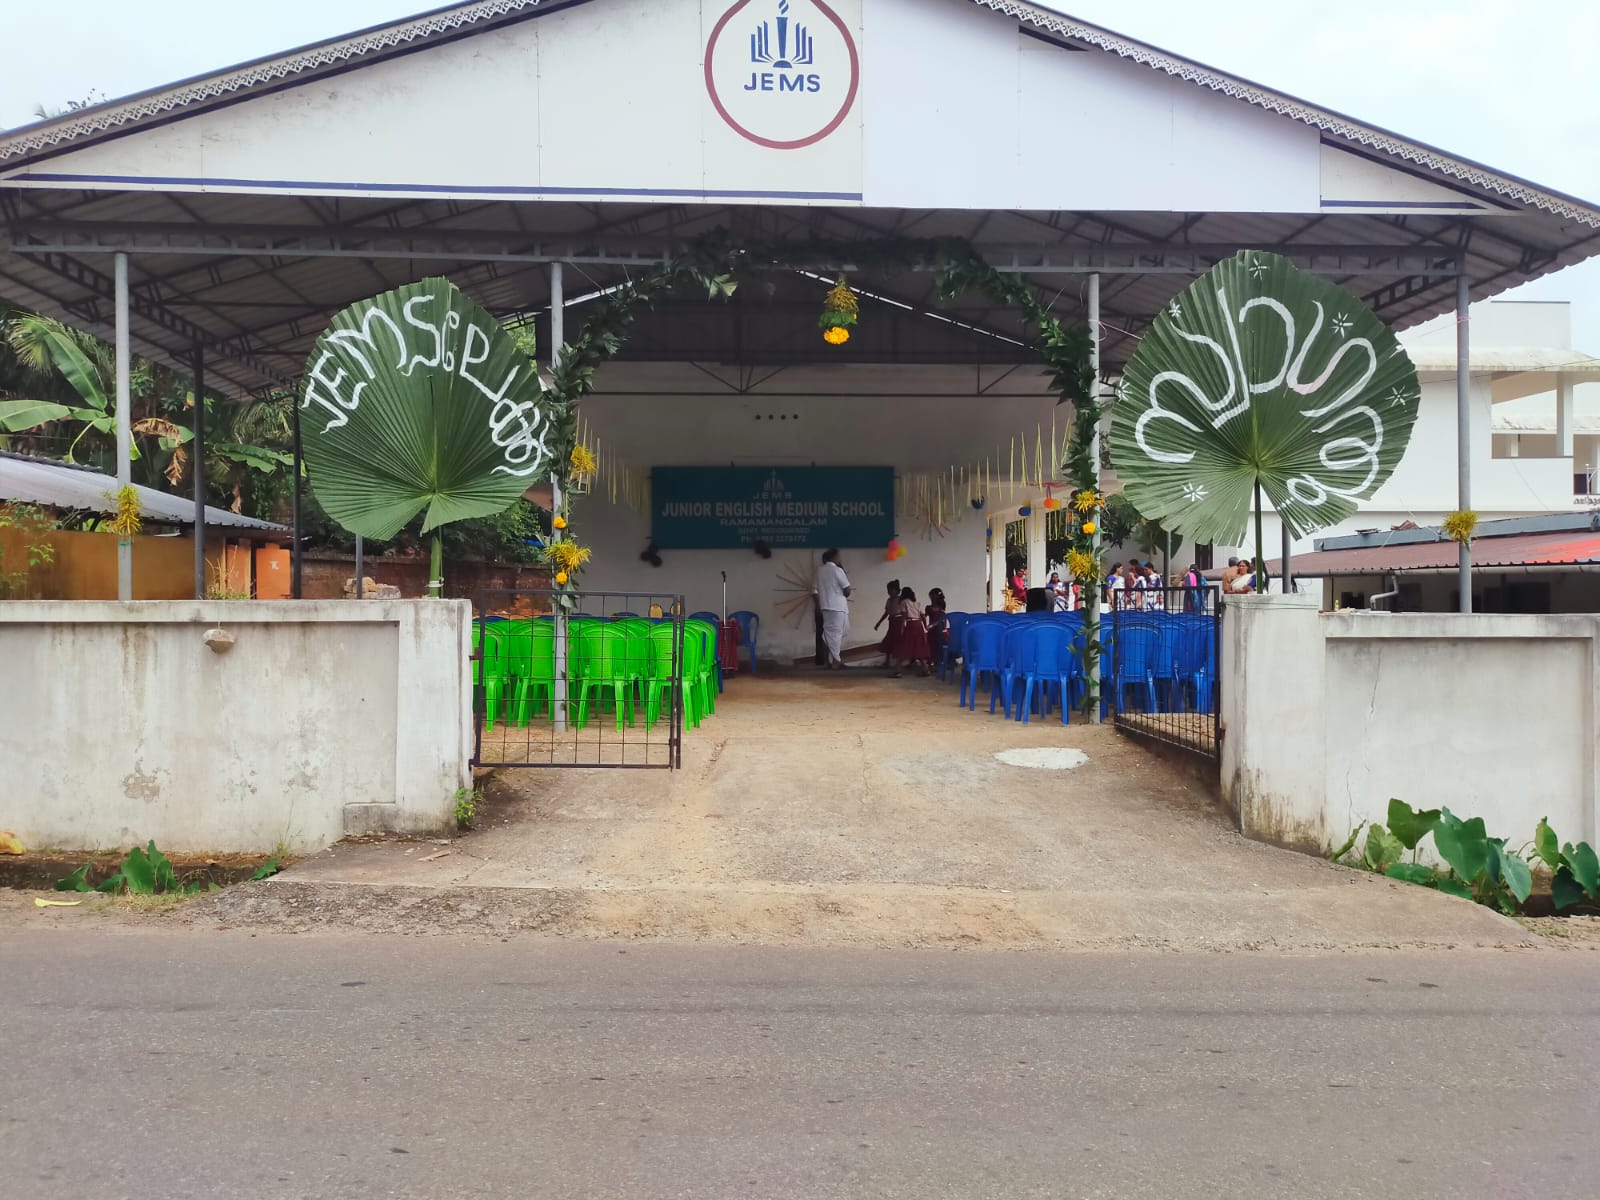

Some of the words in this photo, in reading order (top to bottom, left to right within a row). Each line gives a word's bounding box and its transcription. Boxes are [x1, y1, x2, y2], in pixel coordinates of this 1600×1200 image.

[743, 72, 821, 93] JEMS
[662, 502, 712, 518] JUNIOR
[715, 502, 773, 518] ENGLISH
[776, 502, 829, 517] MEDIUM
[832, 502, 885, 517] SCHOOL
[720, 518, 828, 527] RAMAMANGALAM
